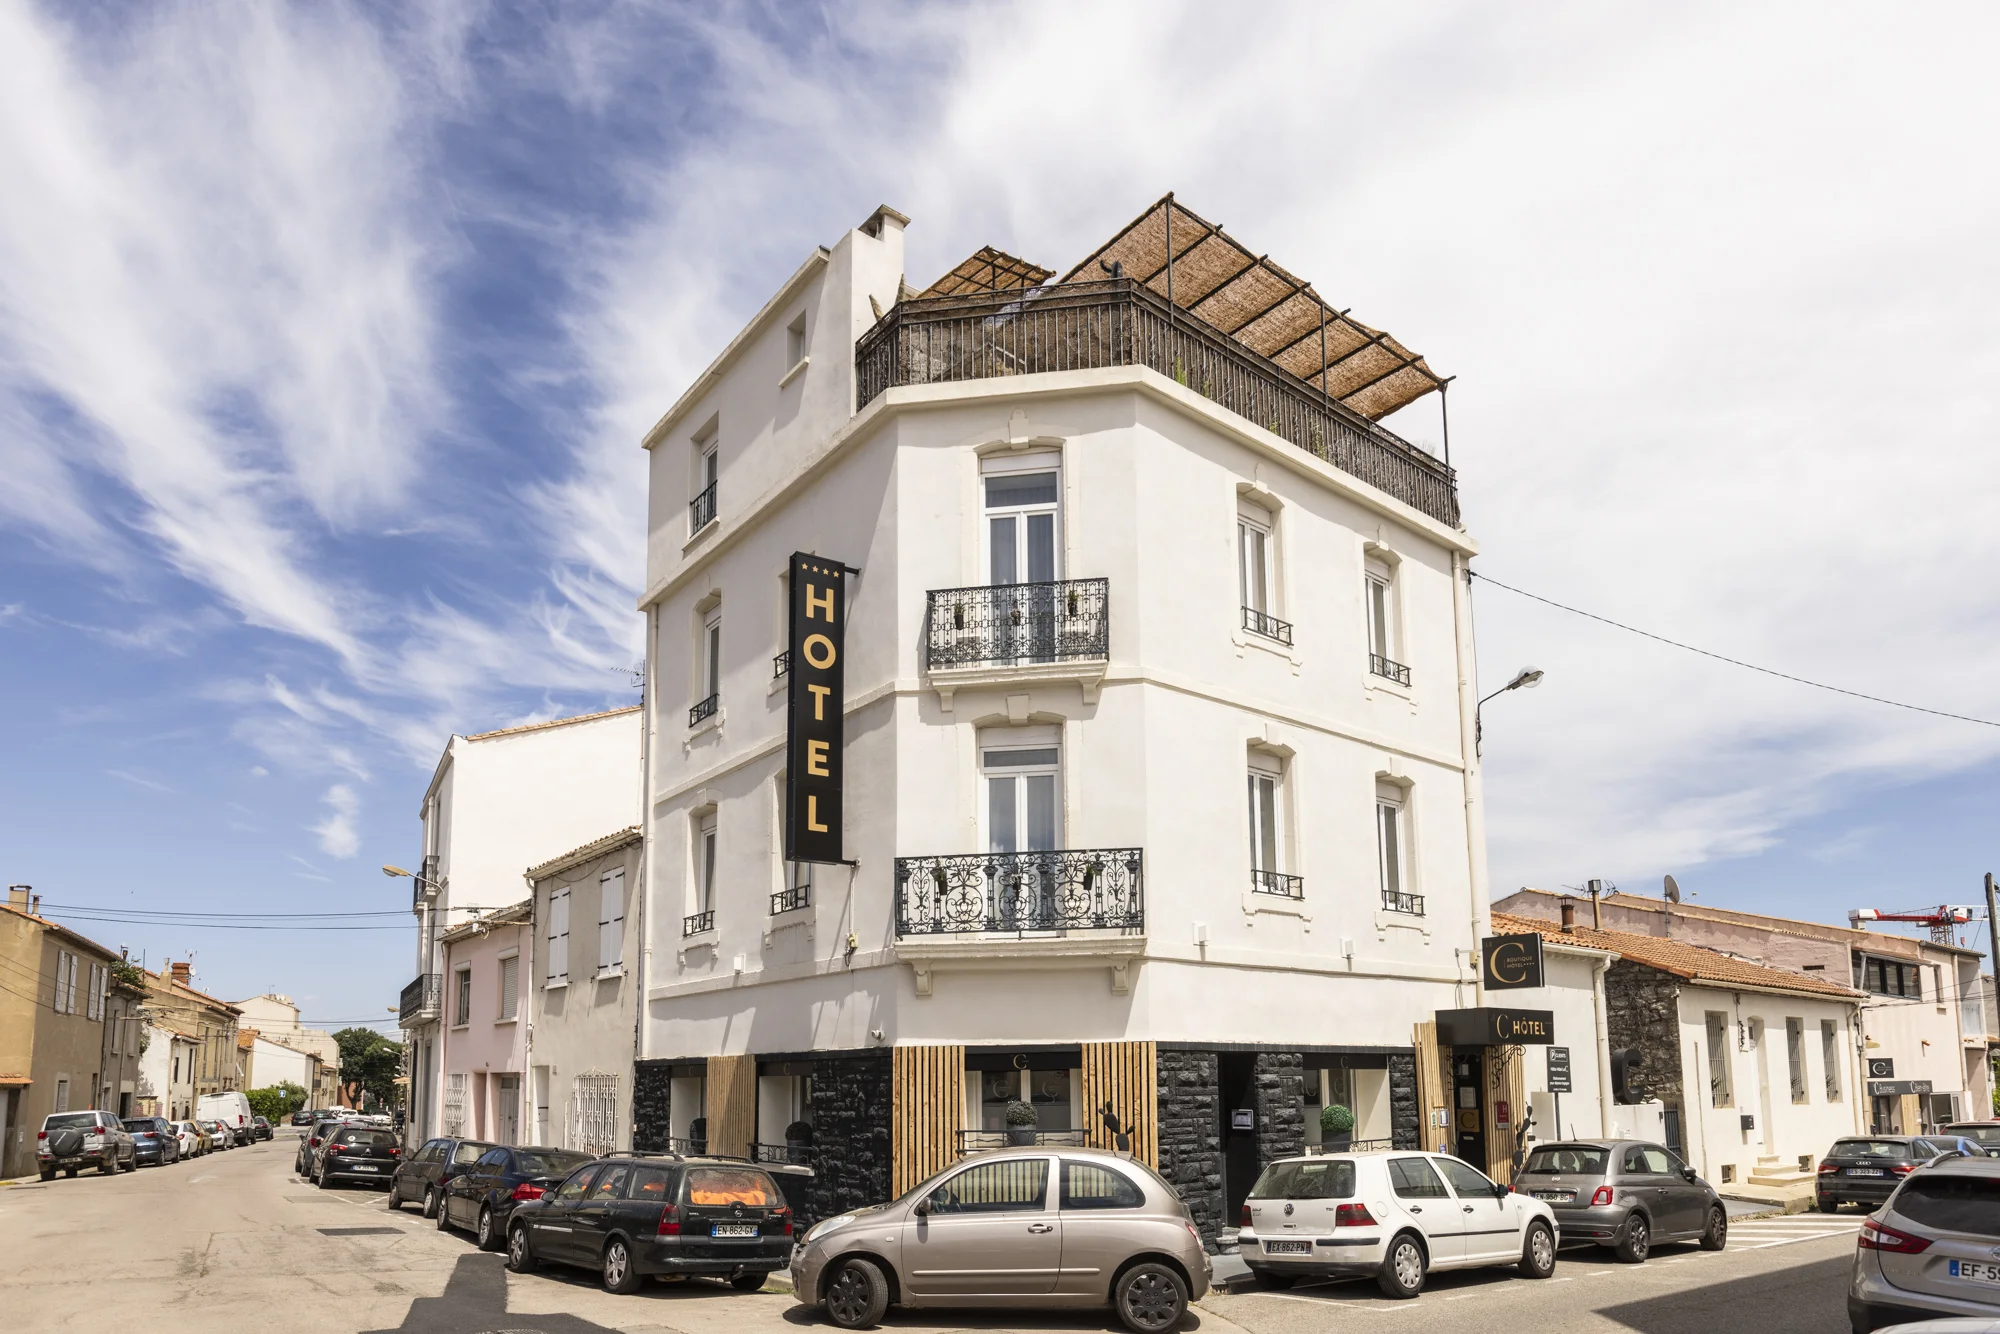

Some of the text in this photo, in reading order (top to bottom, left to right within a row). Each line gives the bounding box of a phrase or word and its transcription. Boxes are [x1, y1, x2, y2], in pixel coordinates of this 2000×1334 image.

[803, 583, 837, 833] HOTEL
[1490, 942, 1527, 984] C
[1512, 1016, 1546, 1036] HÔTEL
[1460, 1111, 1476, 1129] C
[717, 1225, 754, 1235] EN-862-GX
[1272, 1242, 1306, 1252] EX-862-PN
